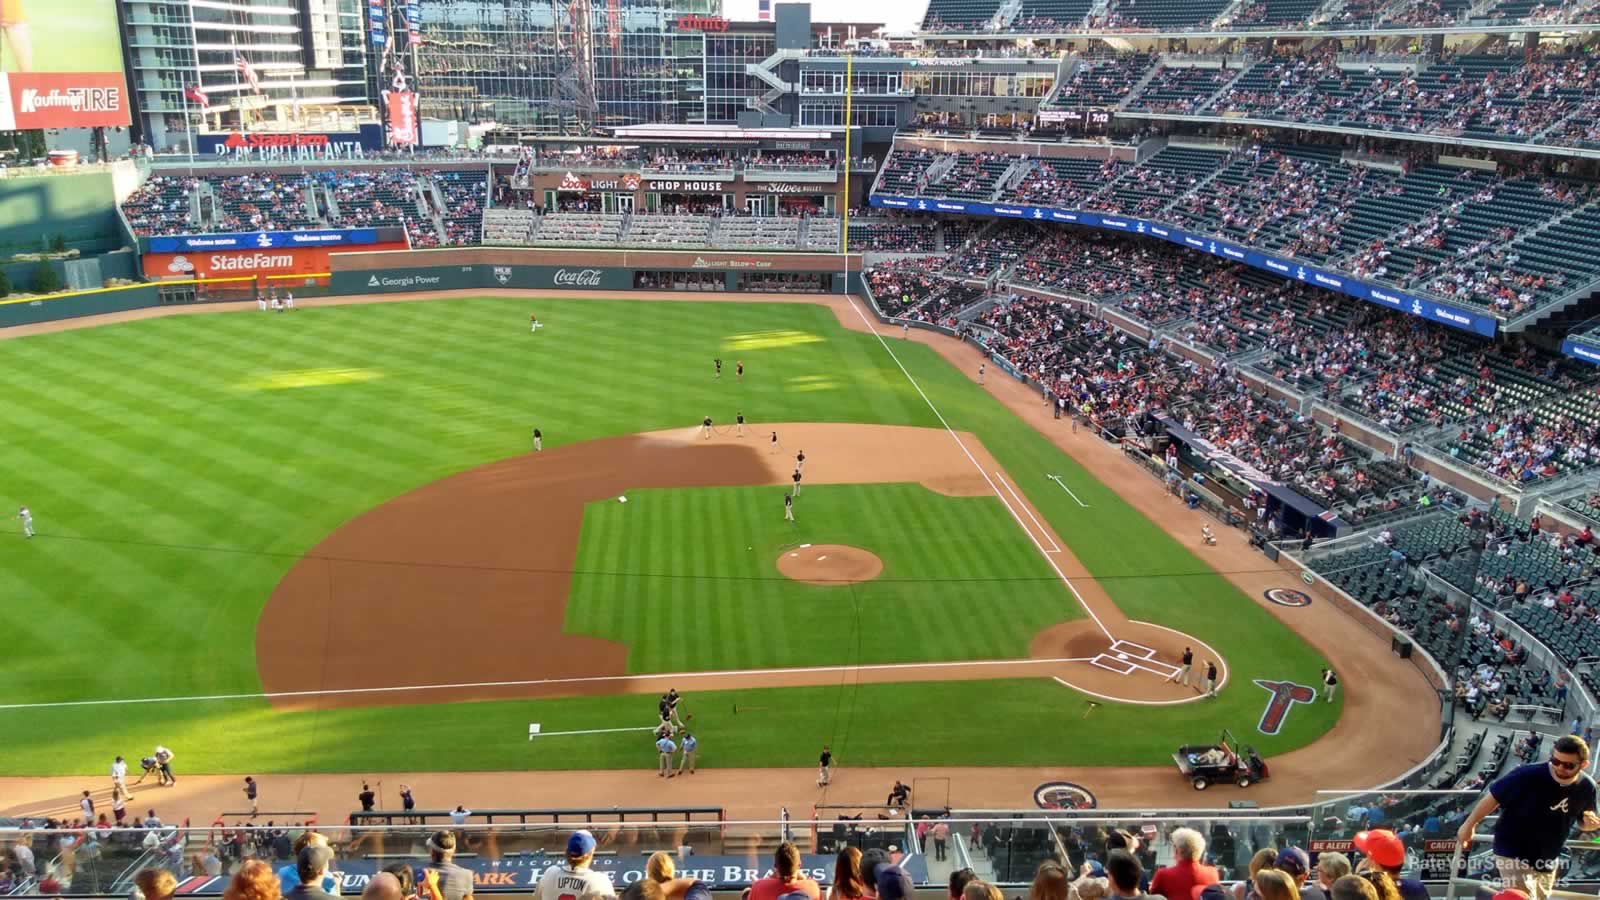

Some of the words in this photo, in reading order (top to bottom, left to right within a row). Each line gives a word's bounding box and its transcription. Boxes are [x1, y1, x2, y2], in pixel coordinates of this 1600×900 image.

[676, 13, 730, 32] xfinity
[67, 87, 119, 112] TIRE
[1092, 113, 1109, 122] 7:12
[591, 180, 619, 189] LIGHT
[650, 181, 680, 190] CHOP
[684, 181, 723, 191] HOUSE
[767, 181, 802, 192] Silver
[210, 253, 293, 271] StateFarm
[382, 277, 414, 286] Georgia
[415, 275, 440, 284] Power
[1313, 842, 1326, 850] BE
[1326, 841, 1352, 850] ALERT
[1430, 842, 1456, 850] CAUTI
[472, 872, 518, 886] ARK
[722, 865, 827, 882] BRAES
[557, 876, 586, 891] UPTON
